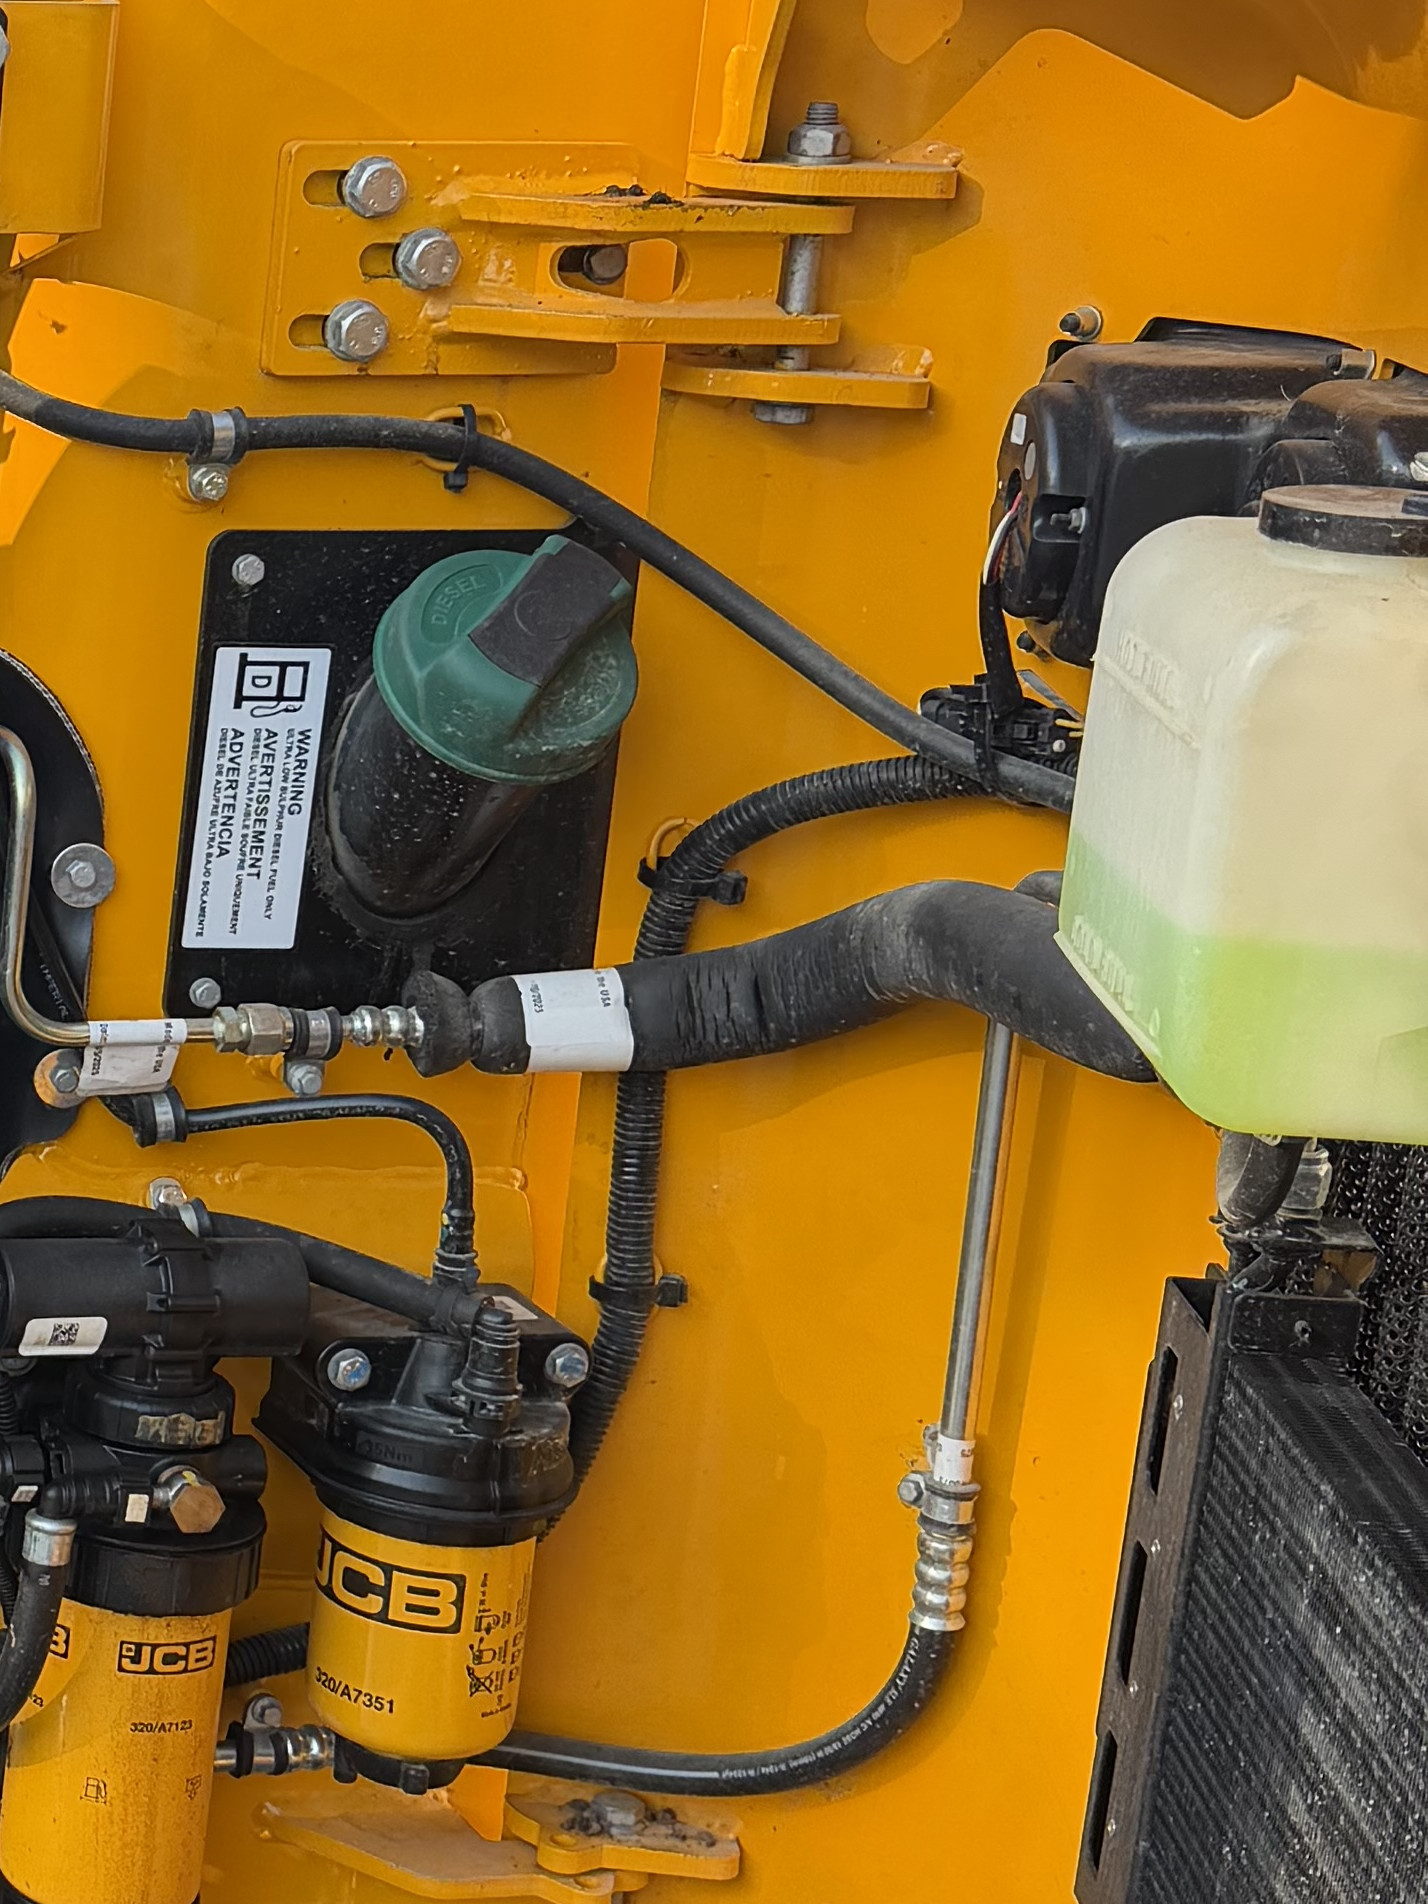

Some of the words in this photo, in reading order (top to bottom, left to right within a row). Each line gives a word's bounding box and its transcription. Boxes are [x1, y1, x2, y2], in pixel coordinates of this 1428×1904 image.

[431, 574, 486, 625] DIESEL
[217, 728, 228, 761] DIESEL
[251, 728, 262, 762] DIESEL
[283, 728, 295, 760] ULTRA
[215, 763, 224, 777] DE
[246, 765, 258, 795] ULTRA
[280, 762, 291, 784] LOW
[288, 728, 312, 816] WARNING
[210, 779, 222, 816] AZUFRE
[216, 728, 244, 858] ADVERTENCIA
[247, 728, 278, 880] AVERTISSEMENT
[206, 819, 218, 850] ULTRA
[270, 833, 282, 865] DIESEL
[203, 852, 214, 878] BAJO
[267, 868, 278, 893] FUEL
[196, 880, 210, 938] SOLAMENTE
[229, 873, 244, 935] UNIQUEMENT
[264, 895, 274, 920] ONLY
[120, 1640, 214, 1672] JCB
[316, 1666, 394, 1714] 320/A7351
[130, 1719, 193, 1735] 320/A7123
